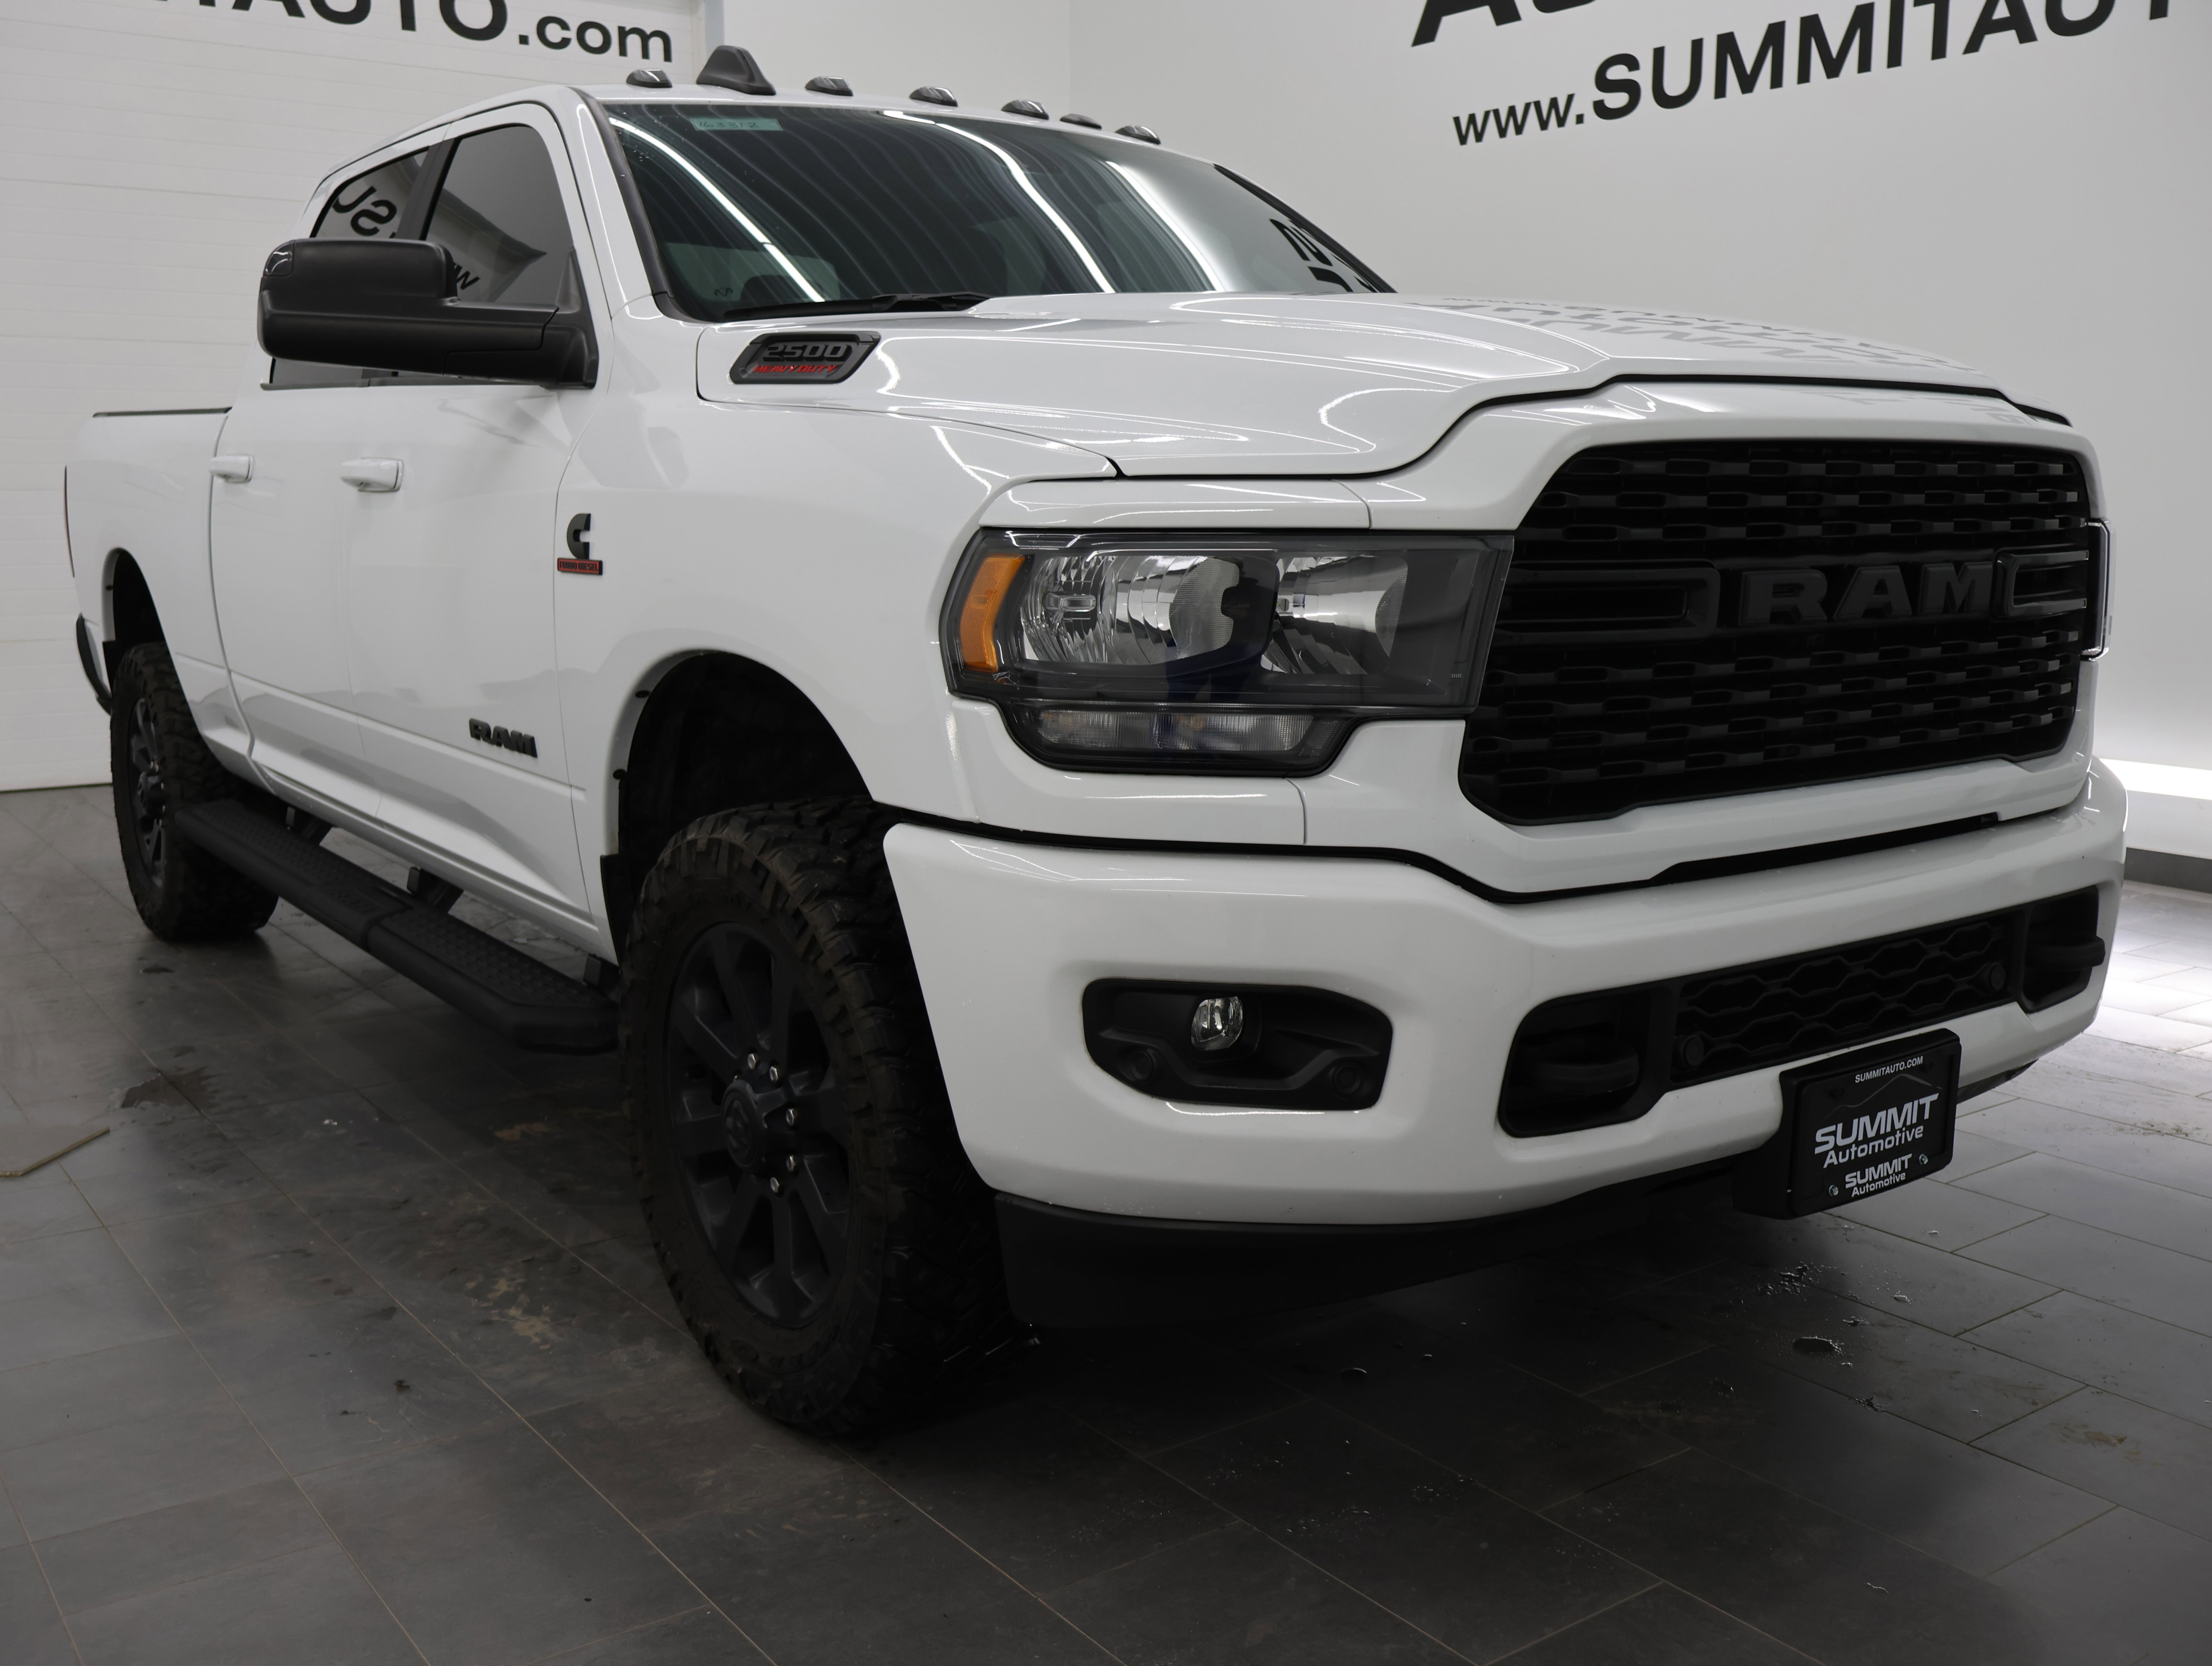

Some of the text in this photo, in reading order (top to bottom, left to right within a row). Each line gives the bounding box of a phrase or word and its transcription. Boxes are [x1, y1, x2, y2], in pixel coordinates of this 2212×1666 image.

[1453, 0, 2168, 146] www.SUMMITAU
[753, 365, 838, 373] HEAVY DUTY
[763, 344, 852, 361] 2500
[1741, 561, 1993, 624] RAM
[469, 718, 538, 758] RAM
[1855, 1056, 1923, 1083] SUMMITAUTO.COM
[1814, 1093, 1939, 1154] SUMMIT
[1823, 1125, 1924, 1169] Automotive
[1845, 1153, 1912, 1189] SUMMIT
[1851, 1172, 1906, 1197] Automotive
